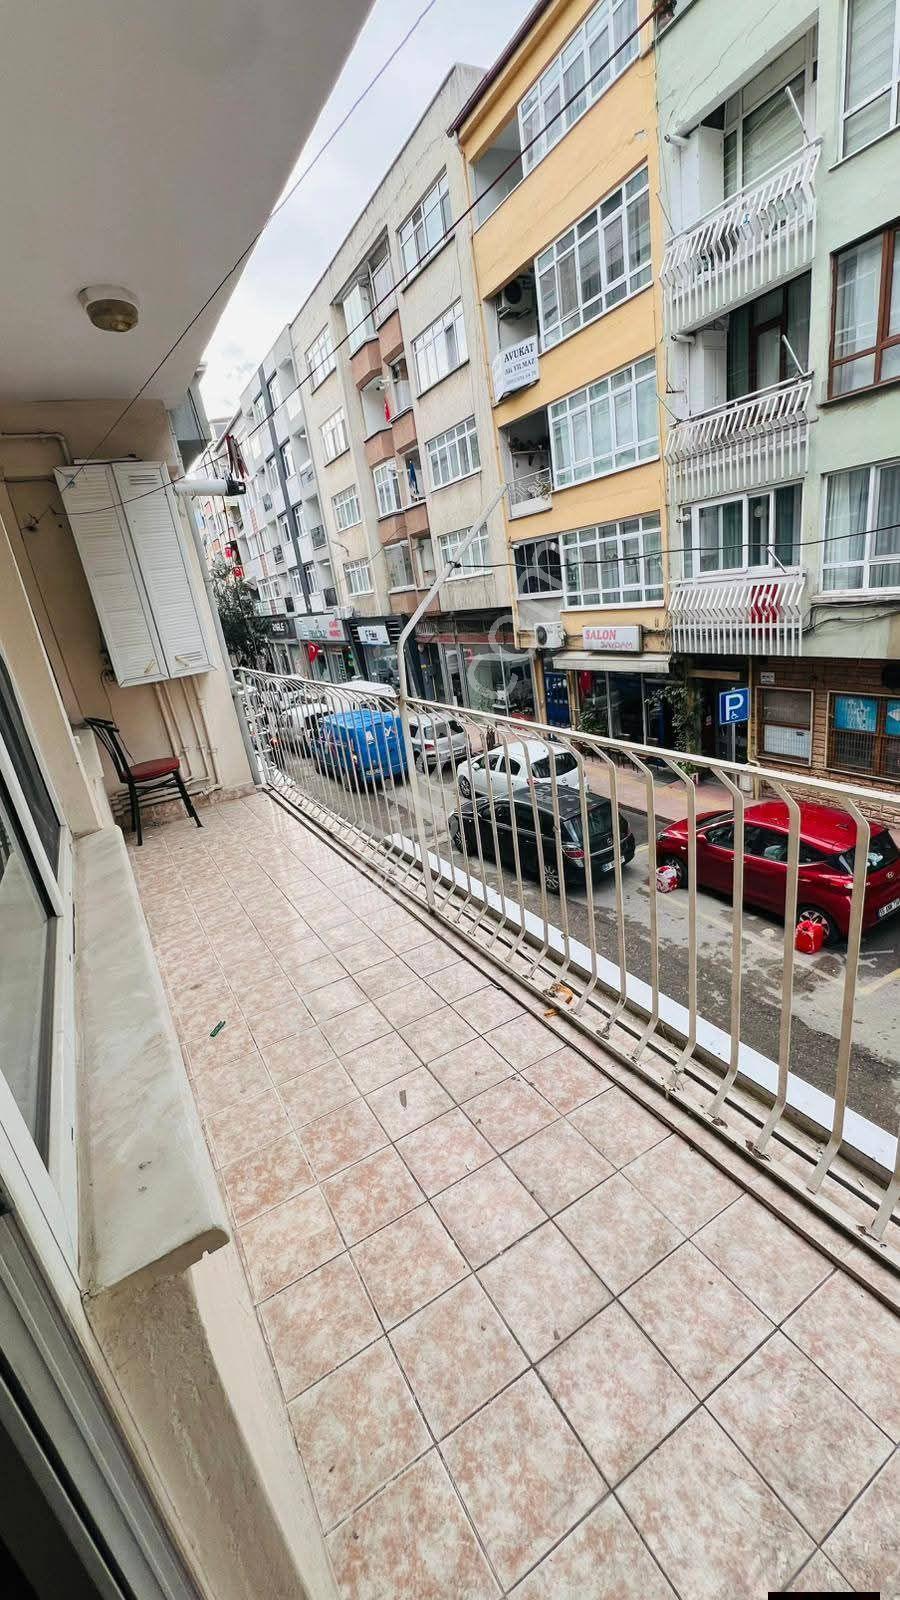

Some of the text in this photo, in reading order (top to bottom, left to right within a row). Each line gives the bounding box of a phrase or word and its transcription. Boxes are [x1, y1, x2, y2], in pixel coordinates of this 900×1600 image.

[504, 343, 534, 363] AVUKAT
[585, 629, 616, 641] SALON
[725, 693, 744, 721] P
